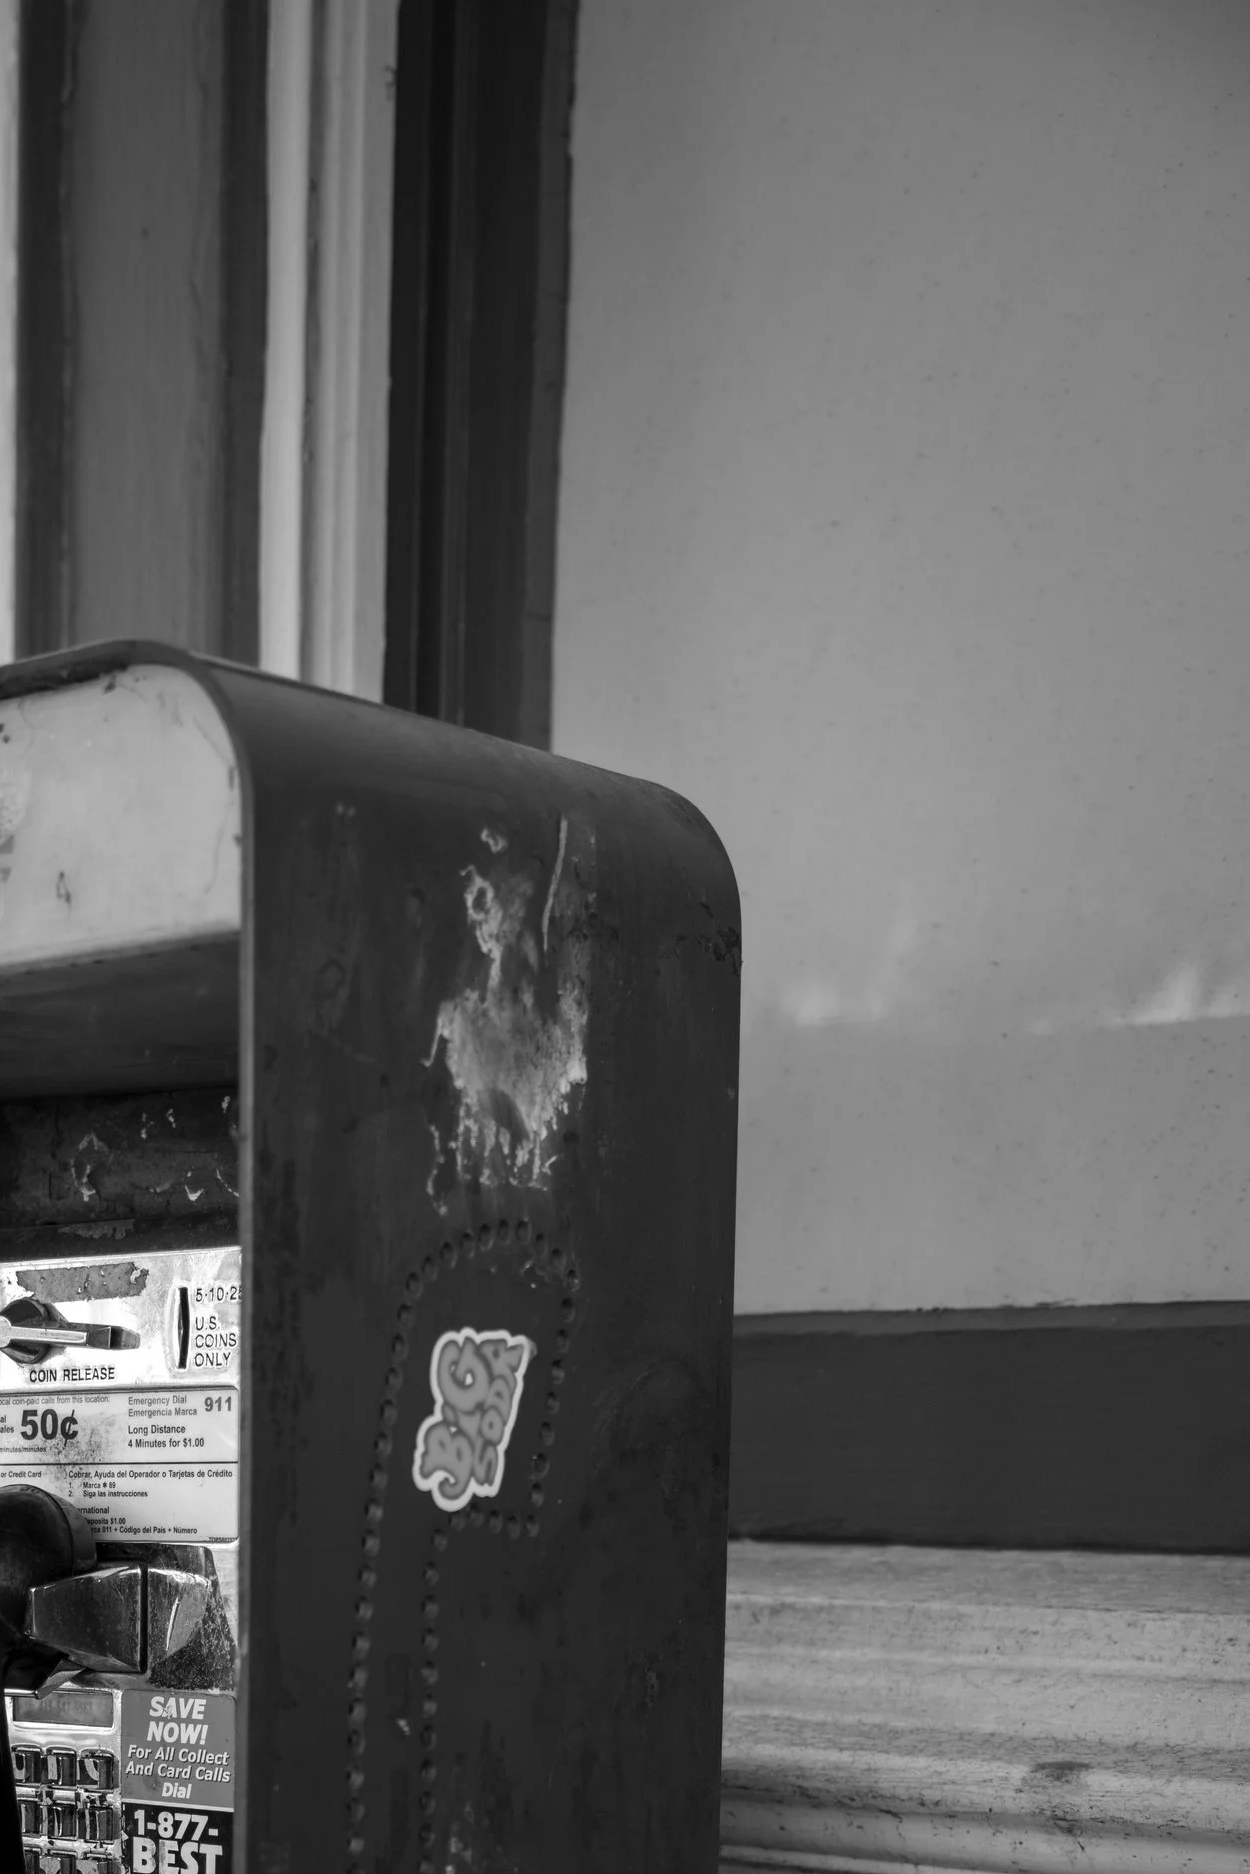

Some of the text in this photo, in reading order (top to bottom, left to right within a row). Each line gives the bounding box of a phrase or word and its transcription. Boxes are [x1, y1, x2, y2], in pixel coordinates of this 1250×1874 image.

[195, 1316, 220, 1330] U.S.
[195, 1333, 237, 1348] COINS
[194, 1353, 231, 1367] ONLY
[29, 1367, 115, 1383] COIN RELEASE
[12, 1397, 40, 1406] coin-paid
[56, 1396, 71, 1404] from
[72, 1396, 83, 1404] this
[128, 1395, 187, 1406] Emergency Dial
[204, 1396, 232, 1413] 911
[128, 1407, 197, 1419] Emergencia Marca
[20, 1408, 79, 1447] 50¢
[128, 1424, 186, 1436] Long Distance
[128, 1437, 205, 1448] 4 Minutes for $1.00
[68, 1470, 93, 1479] Cobrar,
[94, 1470, 115, 1480] Ayuda
[116, 1470, 127, 1478] del
[128, 1470, 160, 1480] Operador
[168, 1469, 195, 1479] Tarjetas
[196, 1469, 206, 1478] de
[207, 1468, 233, 1478] Crédito
[83, 1490, 96, 1498] Siga
[107, 1490, 148, 1498] instrucciones
[110, 1517, 126, 1525] $1.00
[119, 1526, 141, 1535] Código
[173, 1526, 197, 1534] Número
[149, 1696, 207, 1720] SAVE
[147, 1721, 209, 1745] NOW!
[127, 1744, 231, 1766] For All Collect
[125, 1761, 231, 1783] And Card Calls
[162, 1782, 192, 1800] Dial
[134, 1809, 219, 1841] 1-877-
